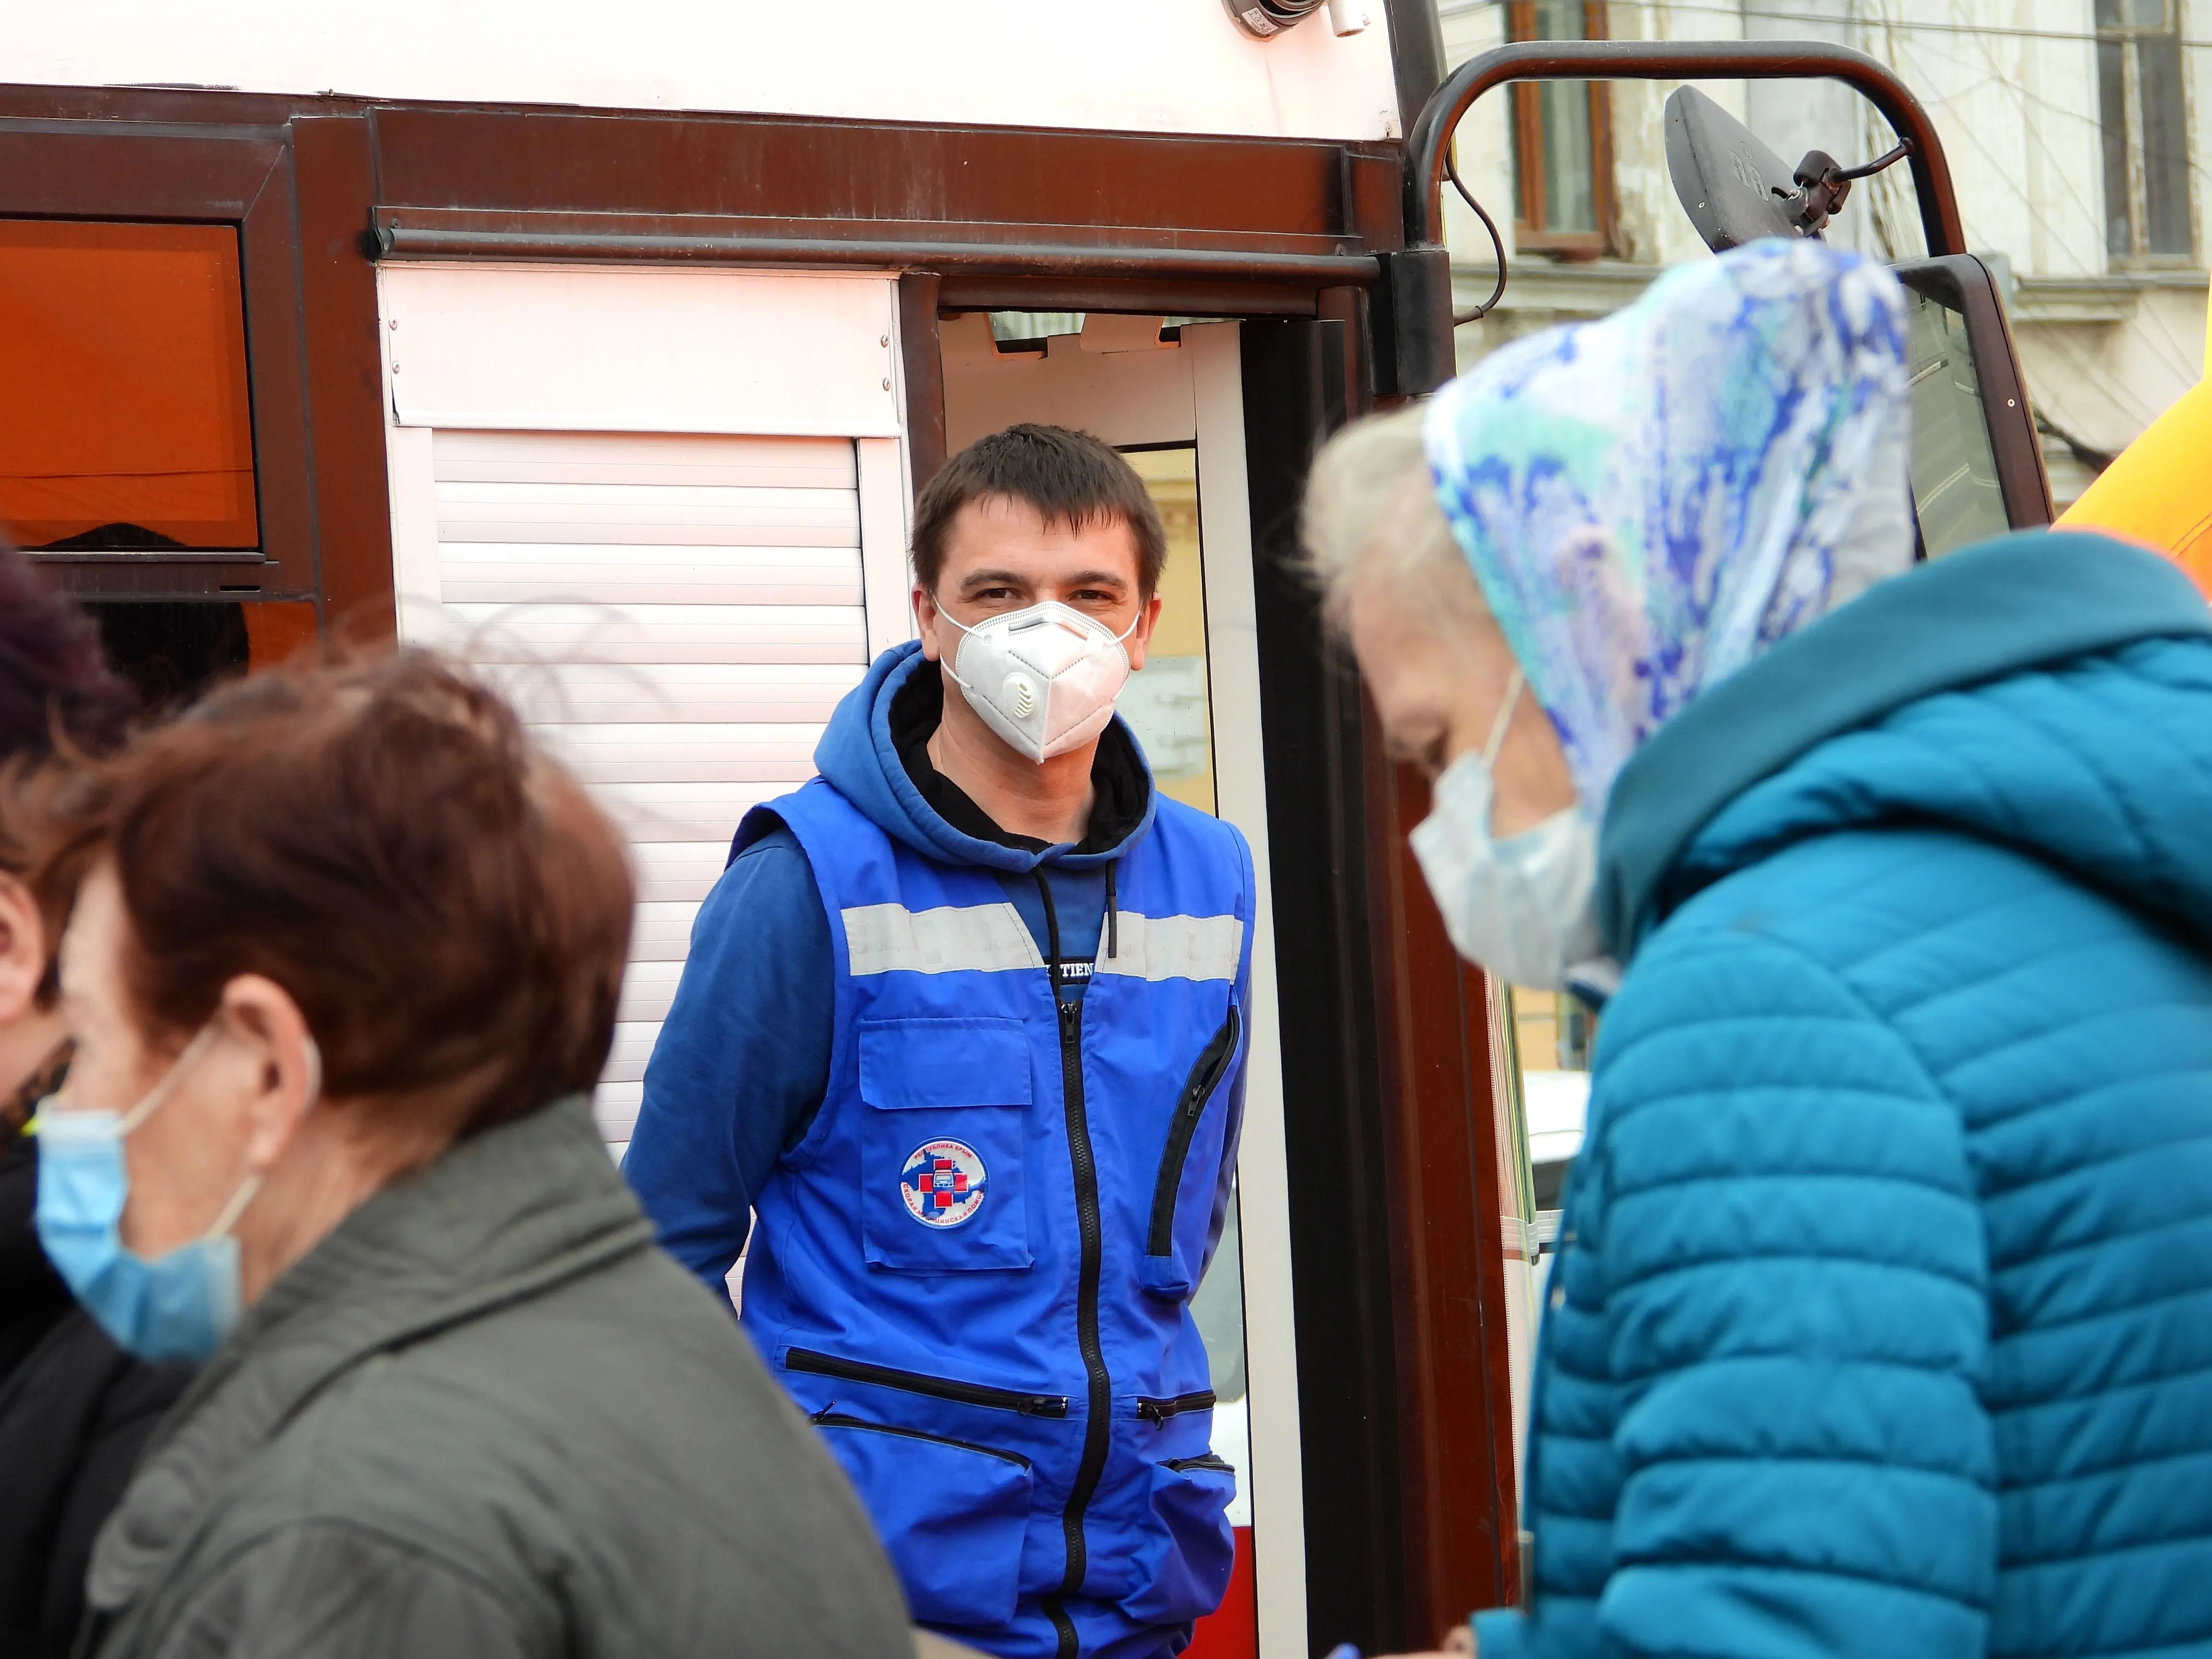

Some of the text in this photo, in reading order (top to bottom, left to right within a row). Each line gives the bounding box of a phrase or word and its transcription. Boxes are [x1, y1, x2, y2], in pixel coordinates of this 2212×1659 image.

[955, 1146, 973, 1158] КРЫМ
[903, 1184, 984, 1224] СКОРАЯ МЕЦИНСКАЯ ПОМО
